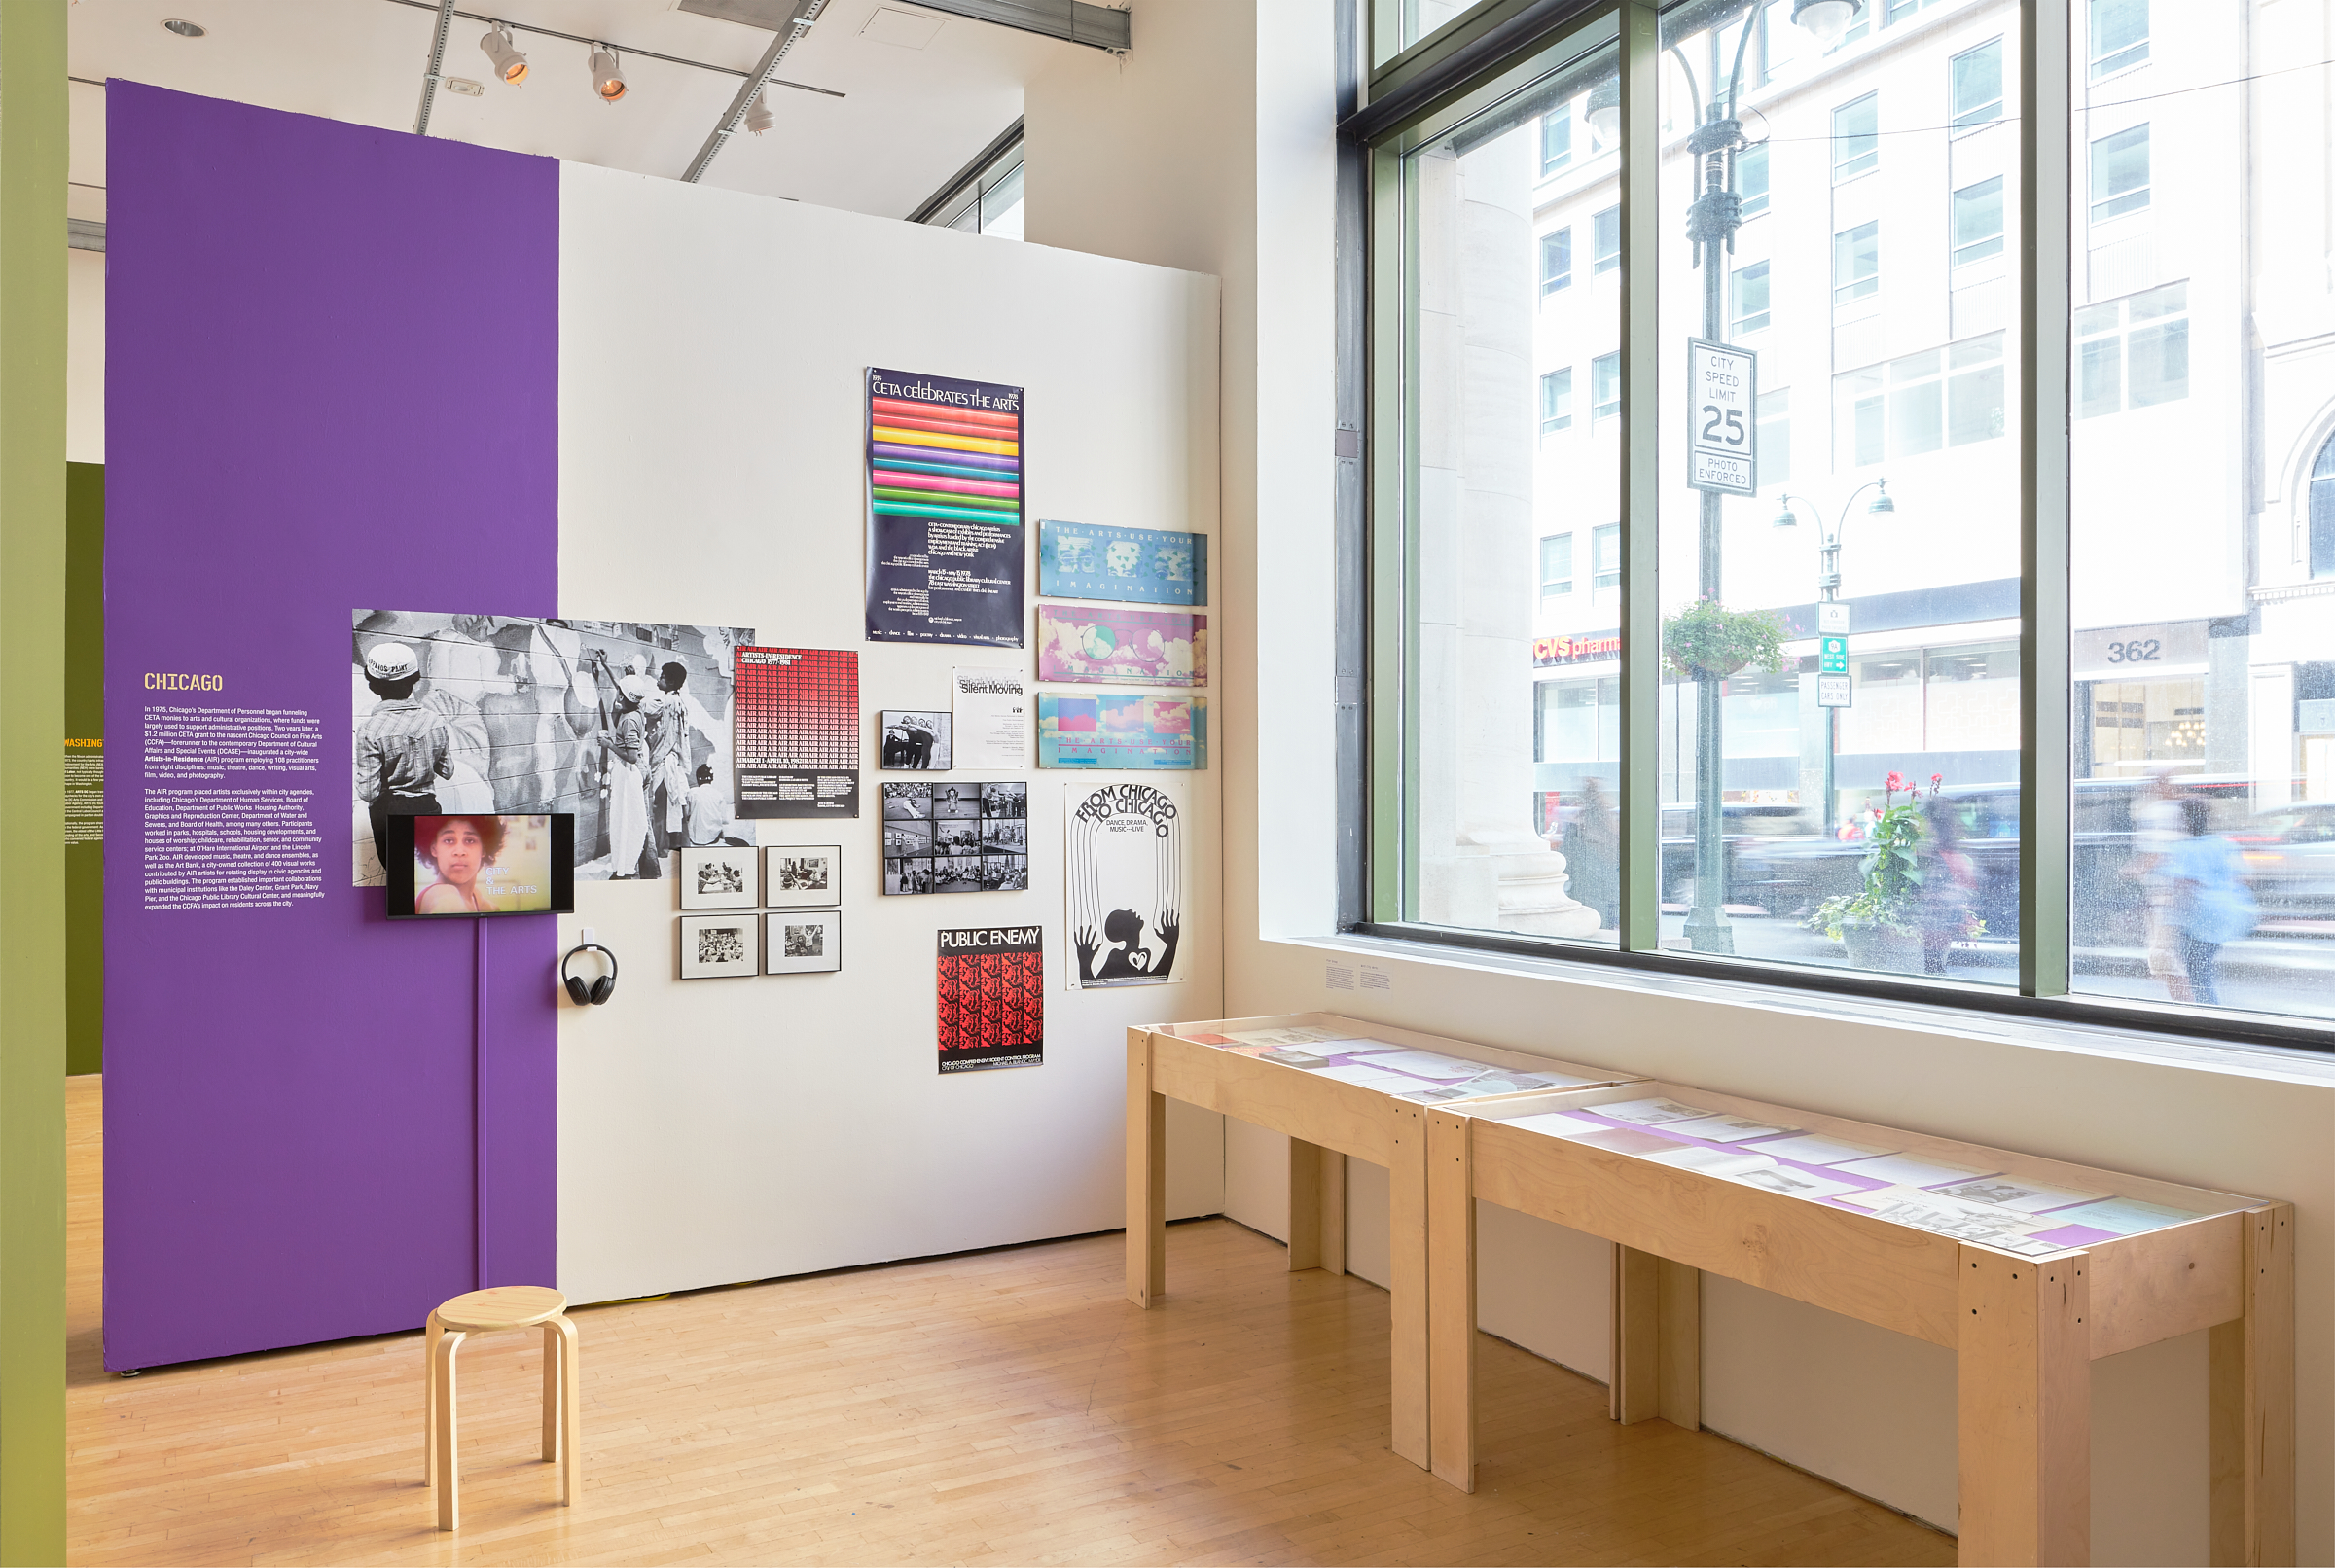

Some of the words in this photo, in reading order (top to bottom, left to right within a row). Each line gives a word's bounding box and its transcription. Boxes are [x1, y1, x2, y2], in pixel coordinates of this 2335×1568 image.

[1711, 356, 1733, 370] CITY
[1706, 371, 1739, 387] SPEED
[872, 382, 901, 396] CETA
[993, 398, 1019, 411] ARTS
[1709, 388, 1736, 402] LIMIT
[1702, 405, 1745, 446] 25
[1708, 458, 1737, 471] PHOTO
[1699, 468, 1747, 484] ENFORCED
[1089, 530, 1121, 538] ARTS
[1056, 580, 1193, 595] IMAGINATION
[1535, 636, 1573, 659] CVS
[2108, 639, 2161, 663] 362
[1053, 666, 1194, 676] IMAGINATION
[145, 673, 223, 691] CHICAGO
[1821, 682, 1848, 690] PASSENGER
[962, 684, 988, 693] Silent
[989, 685, 1023, 696] Moving
[197, 707, 230, 715] Department
[65, 739, 104, 747] WASHING
[1076, 785, 1116, 823] FROM
[1120, 784, 1177, 820] CHICAGO
[1091, 803, 1111, 823] TO
[1116, 798, 1169, 838] CHICAGO
[486, 868, 509, 876] CITY
[941, 930, 987, 948] PUBLIC
[990, 928, 1039, 945] ENEMY
